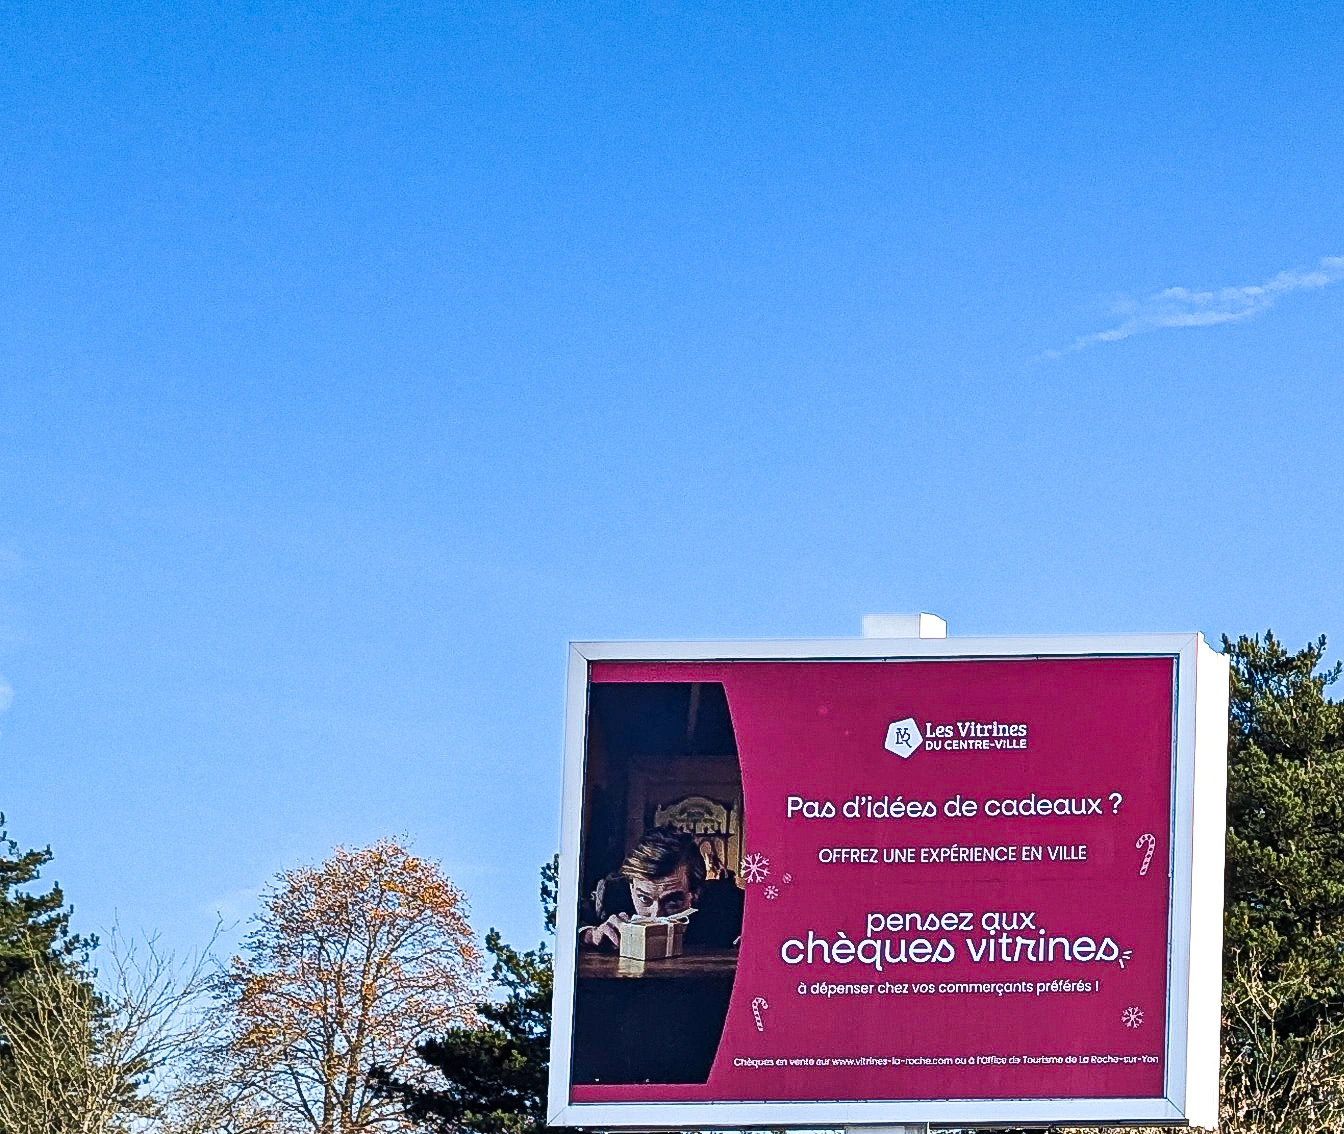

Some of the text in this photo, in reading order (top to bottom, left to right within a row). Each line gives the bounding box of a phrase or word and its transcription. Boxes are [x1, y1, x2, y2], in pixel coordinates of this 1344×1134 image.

[925, 720, 1027, 738] Les Vitrines
[925, 739, 1027, 750] DU CENTRE-VILLE
[787, 792, 1123, 819] Pas d'idées de cadeaux ?
[818, 844, 1087, 864] OFFREZ UNE EXPÉRIENCE EN VILLE
[866, 912, 1036, 937] pensez aux
[781, 928, 1119, 971] chèques vitrines
[798, 981, 807, 995] à
[810, 981, 874, 998] dépenser
[877, 981, 909, 994] chez
[911, 984, 935, 994] vos
[938, 981, 1033, 998] commerçants
[1036, 980, 1092, 996] préférés
[733, 1057, 774, 1069] Chèques
[832, 1056, 953, 1067] www.vitrines-la-roche.com
[954, 1057, 967, 1065] ou
[1008, 1055, 1020, 1064] de
[1023, 1055, 1063, 1064] Tourisme
[1065, 1055, 1077, 1063] de
[1090, 1055, 1159, 1064] Roche-sur-Yon
